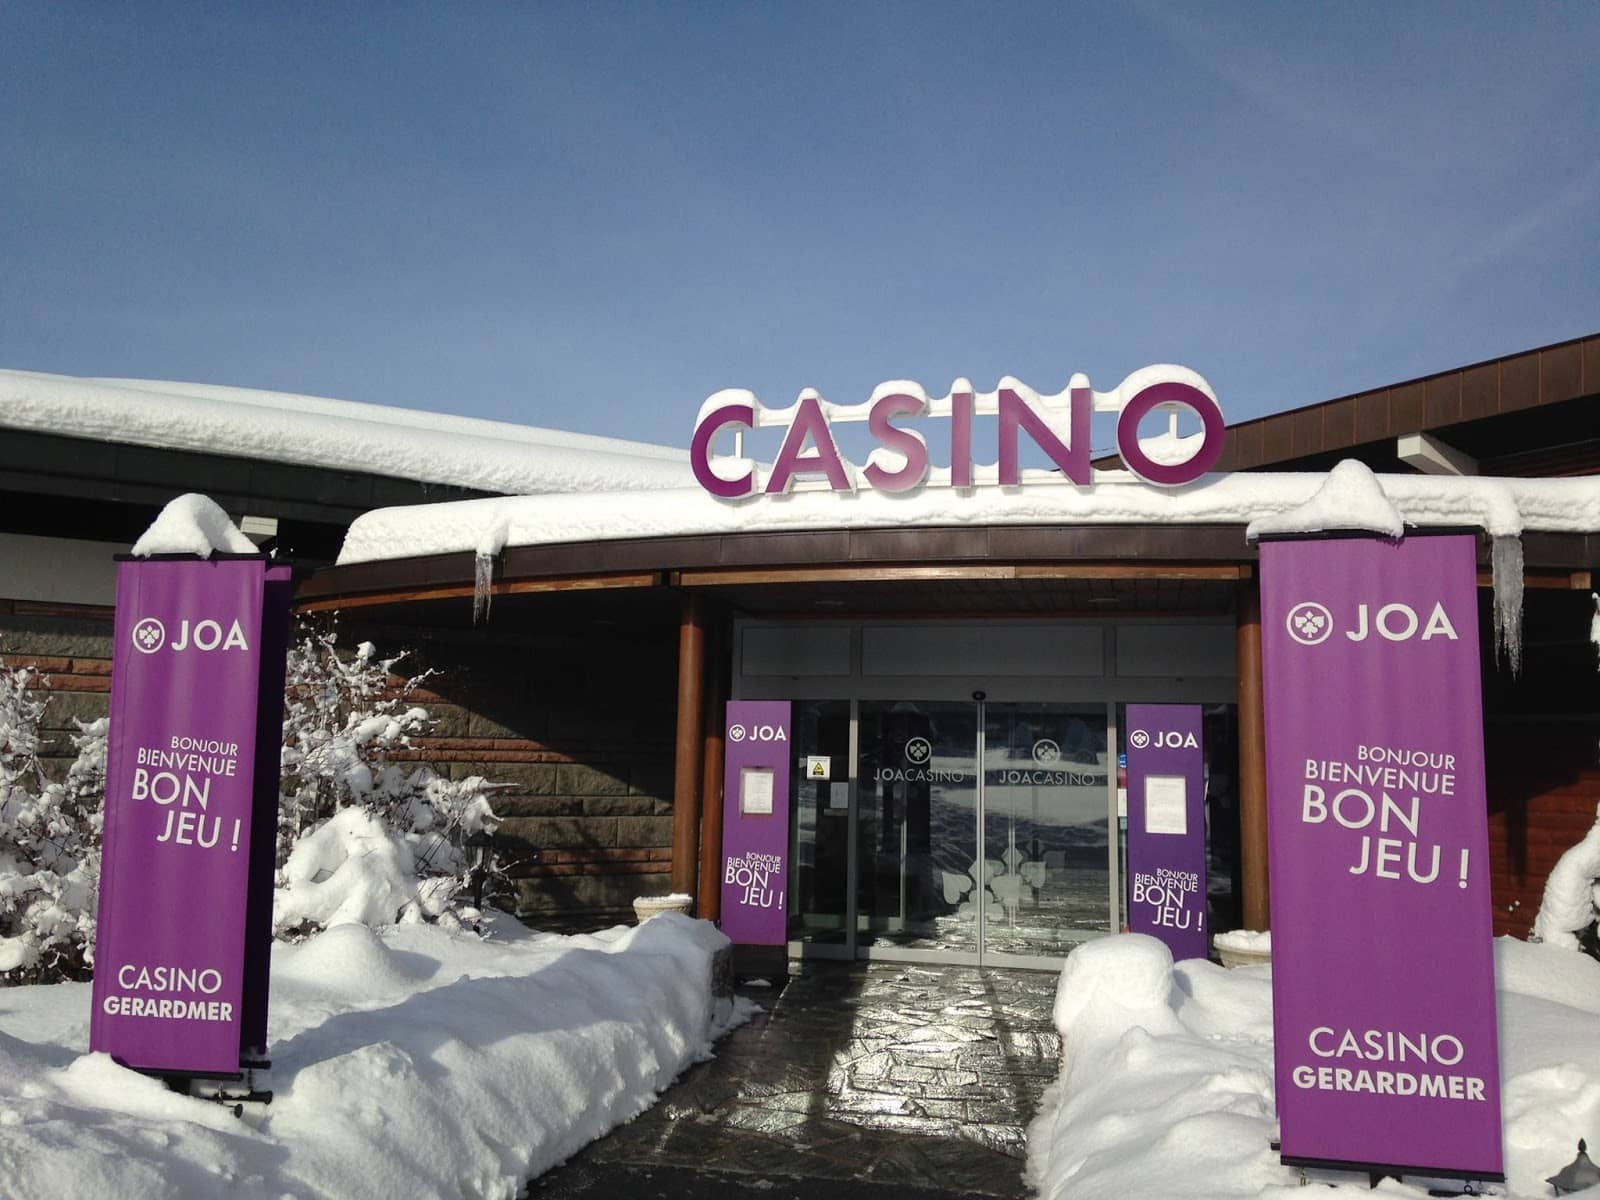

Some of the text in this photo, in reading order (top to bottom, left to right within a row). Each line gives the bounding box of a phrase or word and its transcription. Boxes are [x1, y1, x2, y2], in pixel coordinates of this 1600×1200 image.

[690, 381, 1226, 499] CASINO
[1345, 601, 1459, 643] JOA
[170, 619, 249, 652] JOA
[748, 725, 786, 741] JOA
[1154, 731, 1198, 749] JOA
[170, 736, 238, 757] BONJOUR
[1357, 745, 1455, 771] BONJOUR
[136, 747, 236, 777] BIENVENUE
[131, 768, 211, 810] BON
[1305, 759, 1456, 796] BIENVENUE
[1301, 784, 1421, 838] BON
[156, 809, 241, 852] JEU !
[727, 857, 781, 873] BIENVENUE
[746, 852, 781, 864] BONJOUR
[1348, 836, 1470, 889] JEU !
[725, 868, 769, 889] BON
[1134, 873, 1198, 893] BIENVENUE
[1156, 868, 1199, 882] BONJOUR
[740, 887, 784, 910] JEU !
[1133, 883, 1184, 909] BON
[1151, 907, 1203, 932] JEU !
[118, 964, 222, 994] CASINO
[103, 996, 233, 1022] GERARDMER
[1308, 1027, 1464, 1066] CASINO
[1292, 1065, 1486, 1101] GERARDMER
